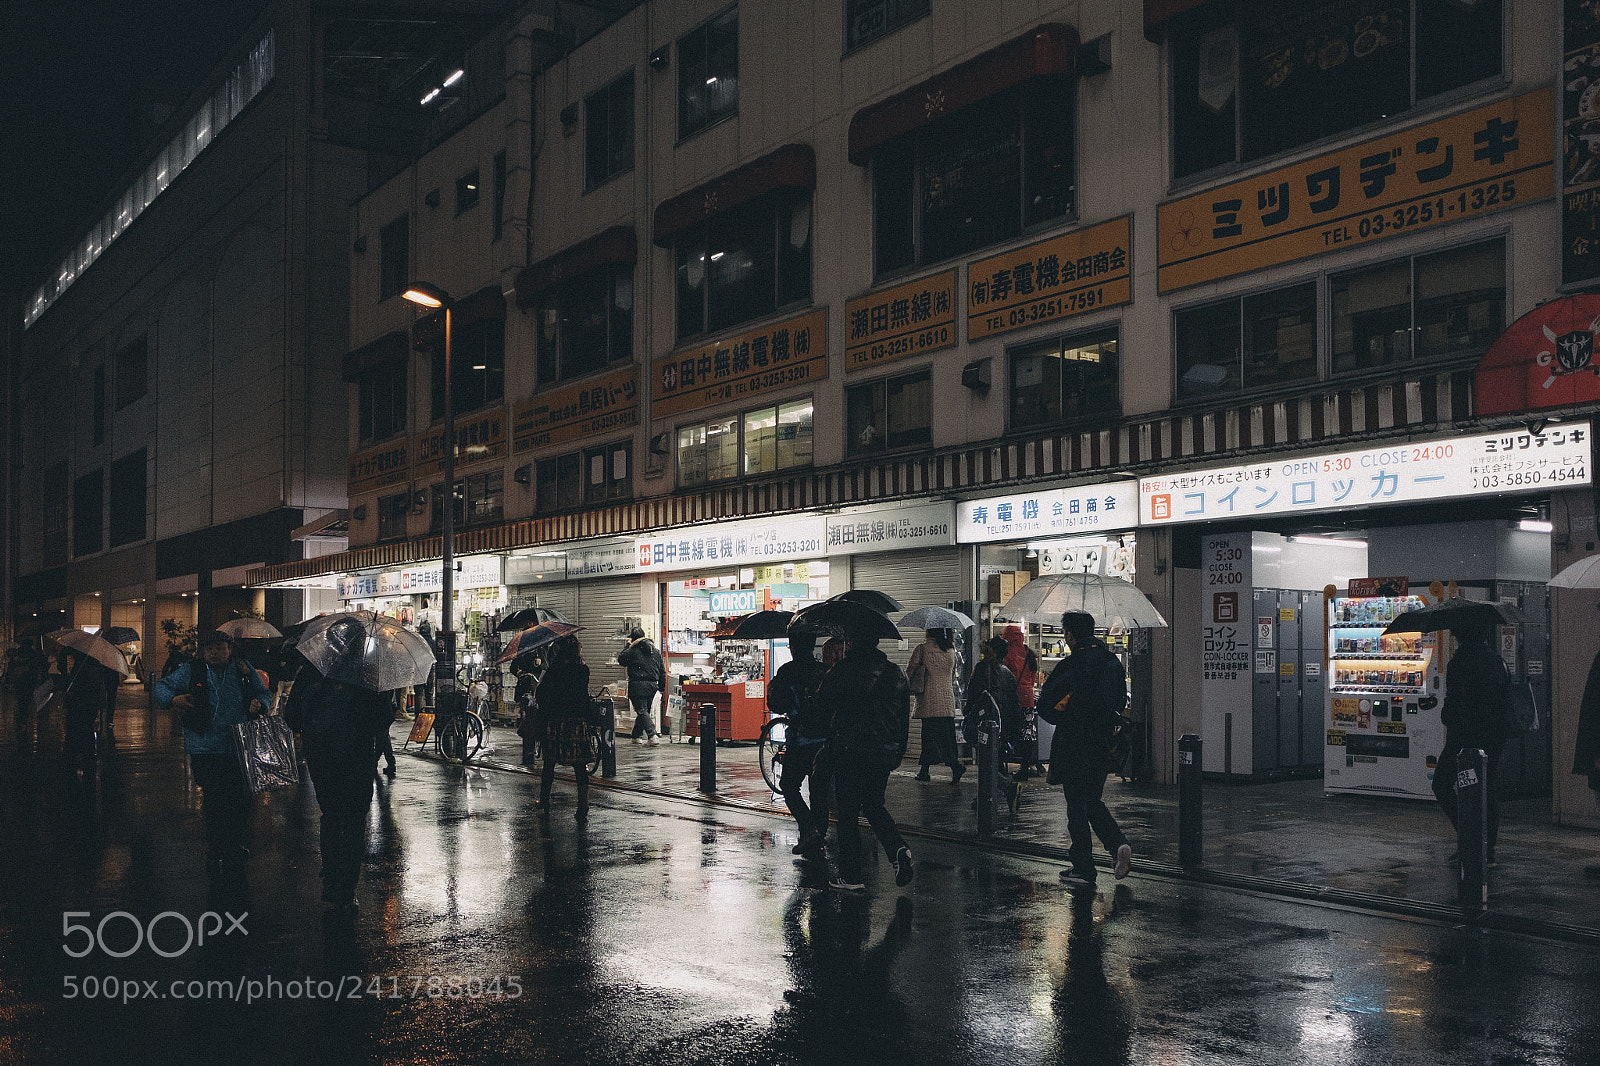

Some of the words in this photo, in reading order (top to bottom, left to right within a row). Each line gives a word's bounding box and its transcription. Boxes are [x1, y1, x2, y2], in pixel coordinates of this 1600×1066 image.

[1212, 116, 1520, 240] ミツワデンキ
[1321, 227, 1354, 247] TEL
[1358, 180, 1518, 242] 03-3251-1325
[986, 317, 1006, 332] TEL
[1009, 288, 1105, 326] 03-3251-7591
[852, 352, 869, 366] TEL
[870, 326, 949, 362] 03-3251-6610
[735, 382, 748, 396] TEL
[750, 365, 811, 392] 03-3253-3201
[1484, 429, 1585, 453] ミツワデンキ
[1282, 461, 1319, 477] OPEN
[1323, 456, 1352, 473] 5:30
[1361, 450, 1408, 469] CLOSE
[1412, 443, 1455, 463] 24:00
[1482, 466, 1586, 489] 03-5850-4544
[1184, 469, 1446, 516] コインロッカー
[898, 518, 912, 527] TEL
[898, 523, 949, 540] 03-3251-6610
[750, 546, 763, 556] TEL
[764, 539, 821, 556] 03-3253-3201
[1208, 541, 1230, 550] OPEN
[1215, 547, 1243, 562] 5:30
[1208, 562, 1233, 572] CLOSE
[1209, 572, 1243, 586] 24:00
[1203, 625, 1237, 639] コイン
[1204, 638, 1249, 652] ロッカー
[1204, 652, 1249, 662] COIN-LOCKER
